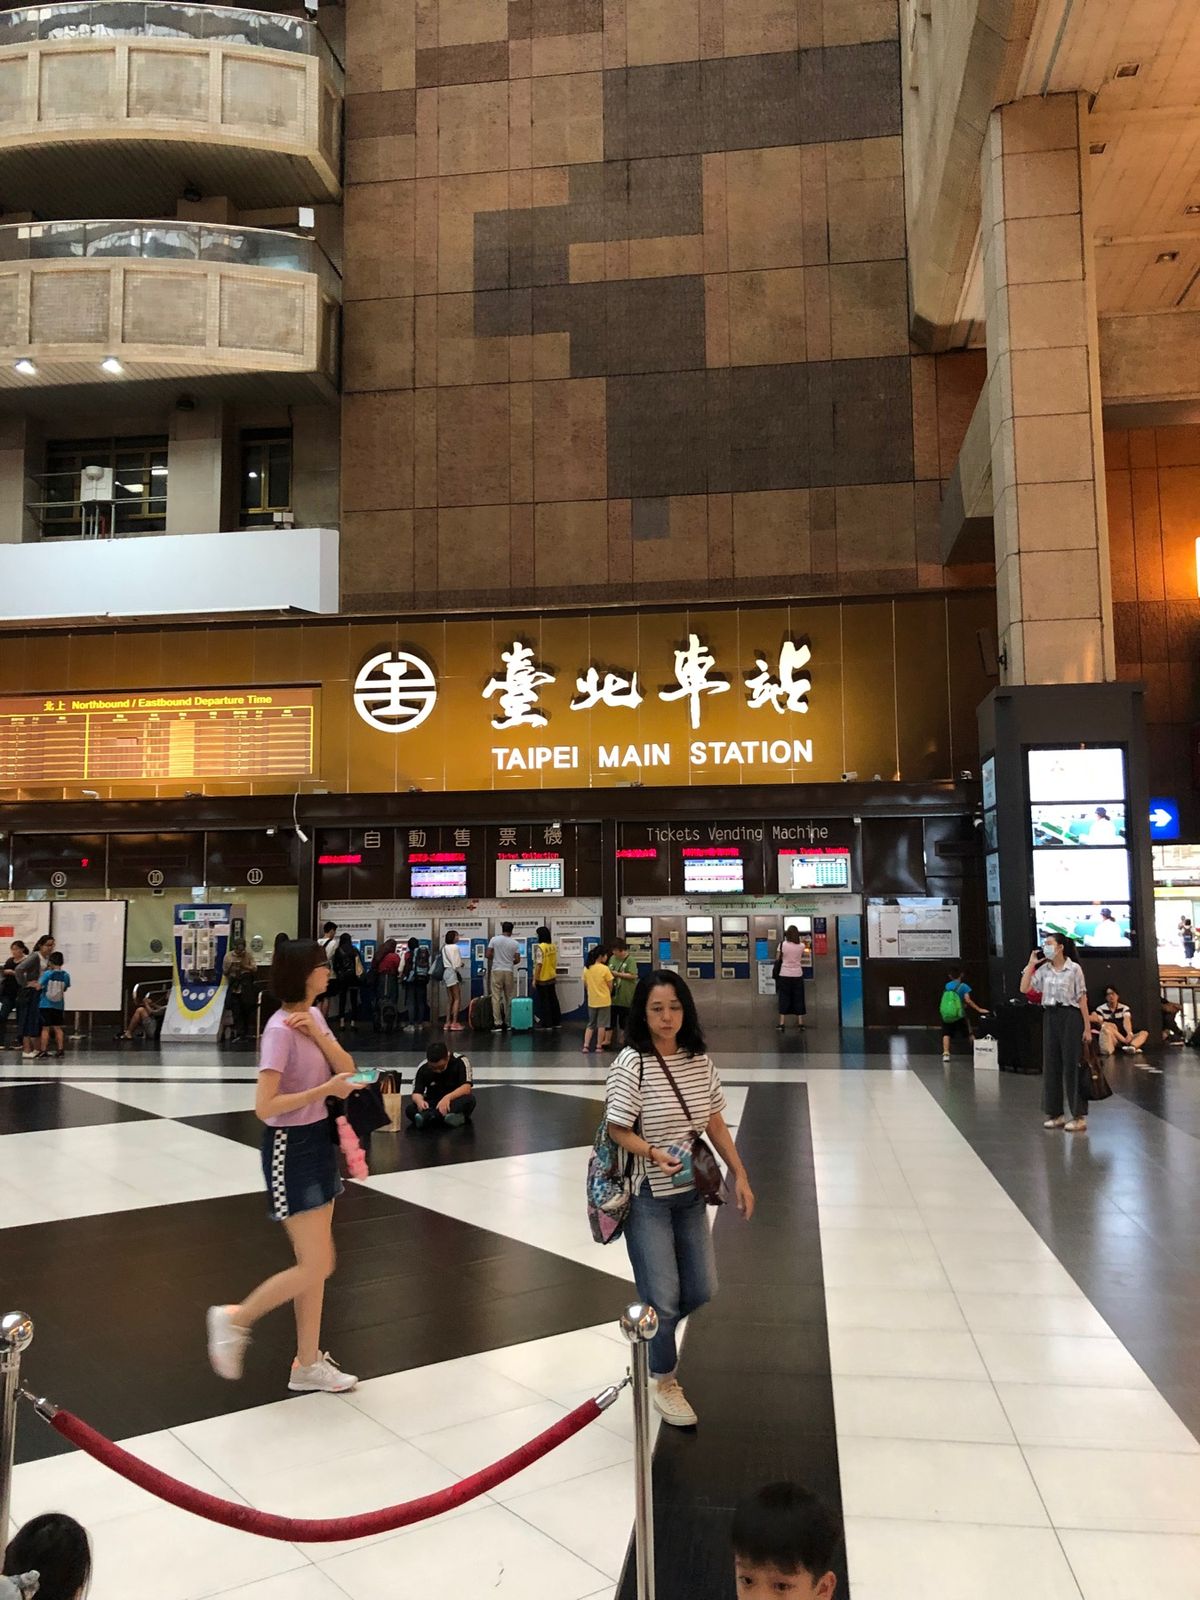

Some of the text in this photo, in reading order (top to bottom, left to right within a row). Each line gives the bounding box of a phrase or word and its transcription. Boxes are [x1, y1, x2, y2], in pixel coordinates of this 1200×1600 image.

[482, 634, 811, 729] 臺北車站
[43, 701, 66, 711] 北上
[72, 699, 130, 709] Northbound
[138, 697, 193, 708] Eastbound
[194, 696, 244, 709] Departure
[247, 695, 272, 704] Time
[491, 739, 813, 770] TAIPEI MAIN STATION
[364, 827, 563, 849] 自動售票機
[647, 825, 829, 841] Tickets Vending Machine
